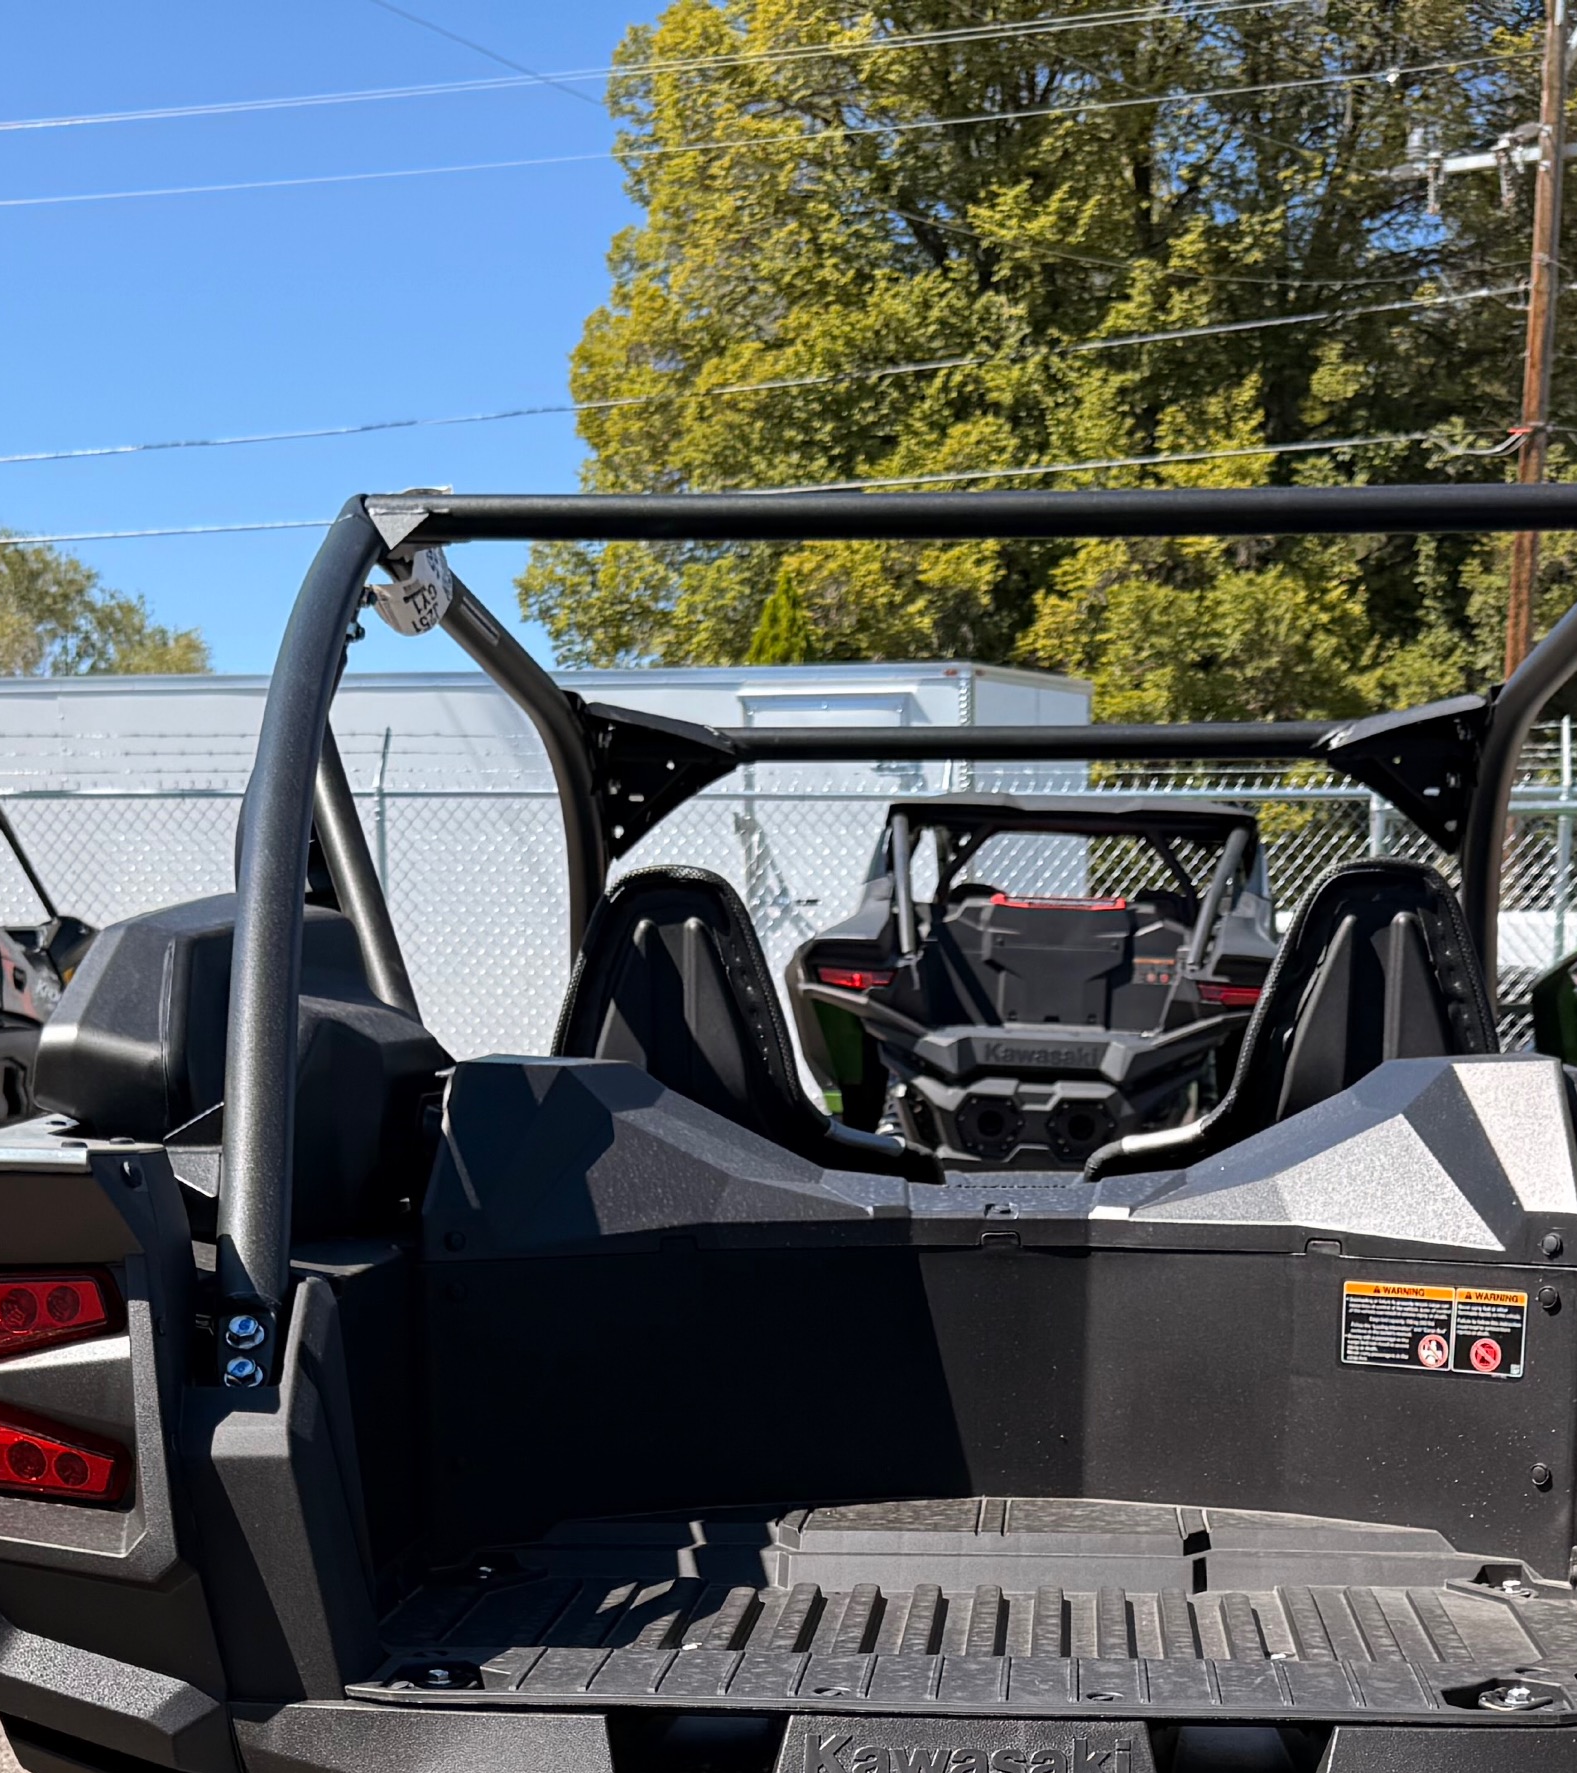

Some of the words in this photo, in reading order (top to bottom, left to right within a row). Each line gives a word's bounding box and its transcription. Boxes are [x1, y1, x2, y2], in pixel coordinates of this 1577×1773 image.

[983, 1042, 1098, 1067] Kawasaki
[1382, 1286, 1426, 1298] WARNING
[1474, 1291, 1519, 1304] WARNING
